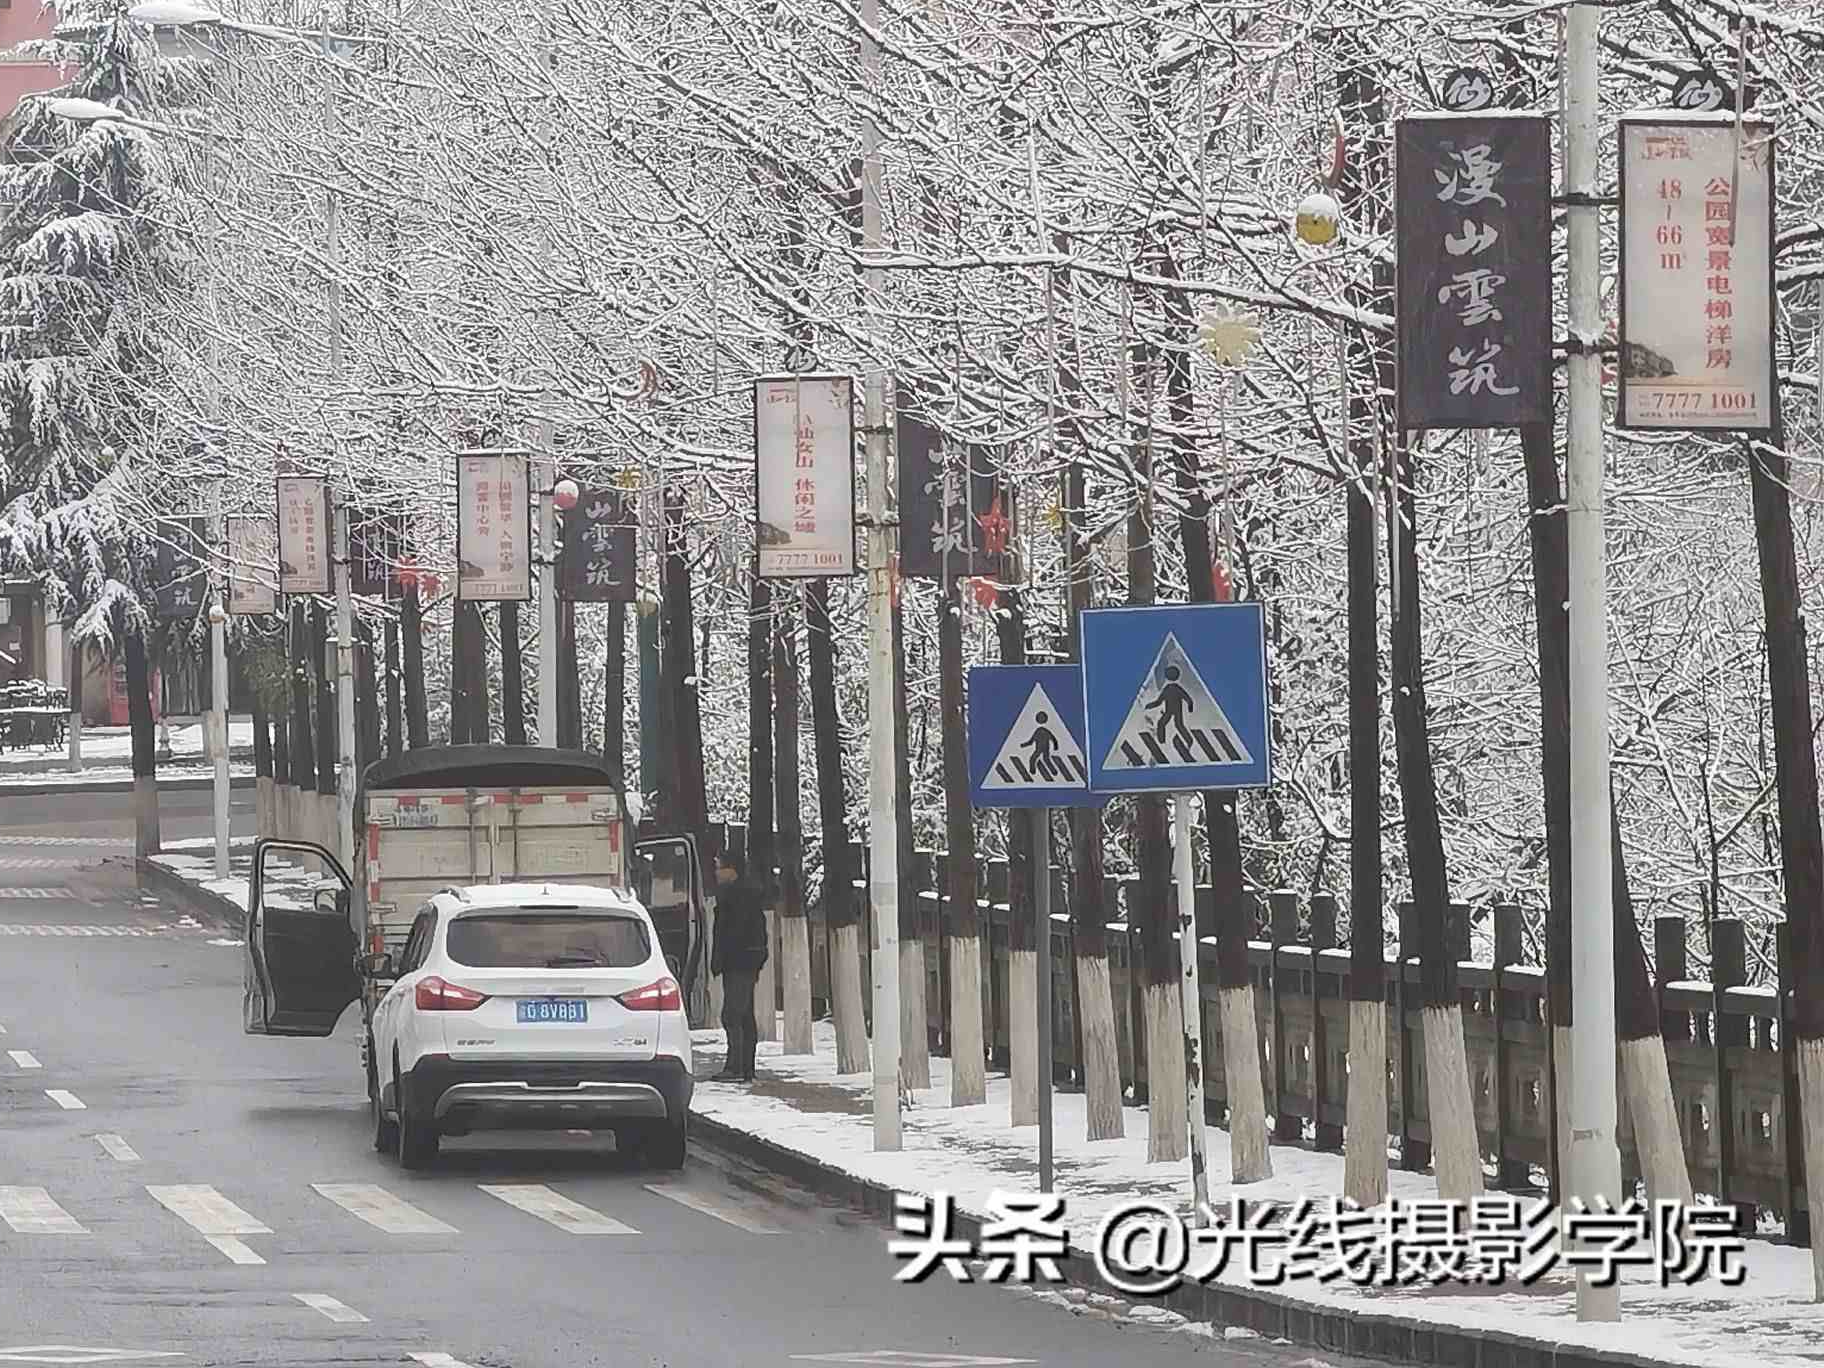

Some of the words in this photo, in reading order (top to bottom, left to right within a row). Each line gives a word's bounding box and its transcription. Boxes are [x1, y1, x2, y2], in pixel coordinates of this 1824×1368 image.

[1652, 392, 1703, 409] 7777
[1711, 392, 1757, 409] 1001
[582, 500, 621, 586] 山雲筑
